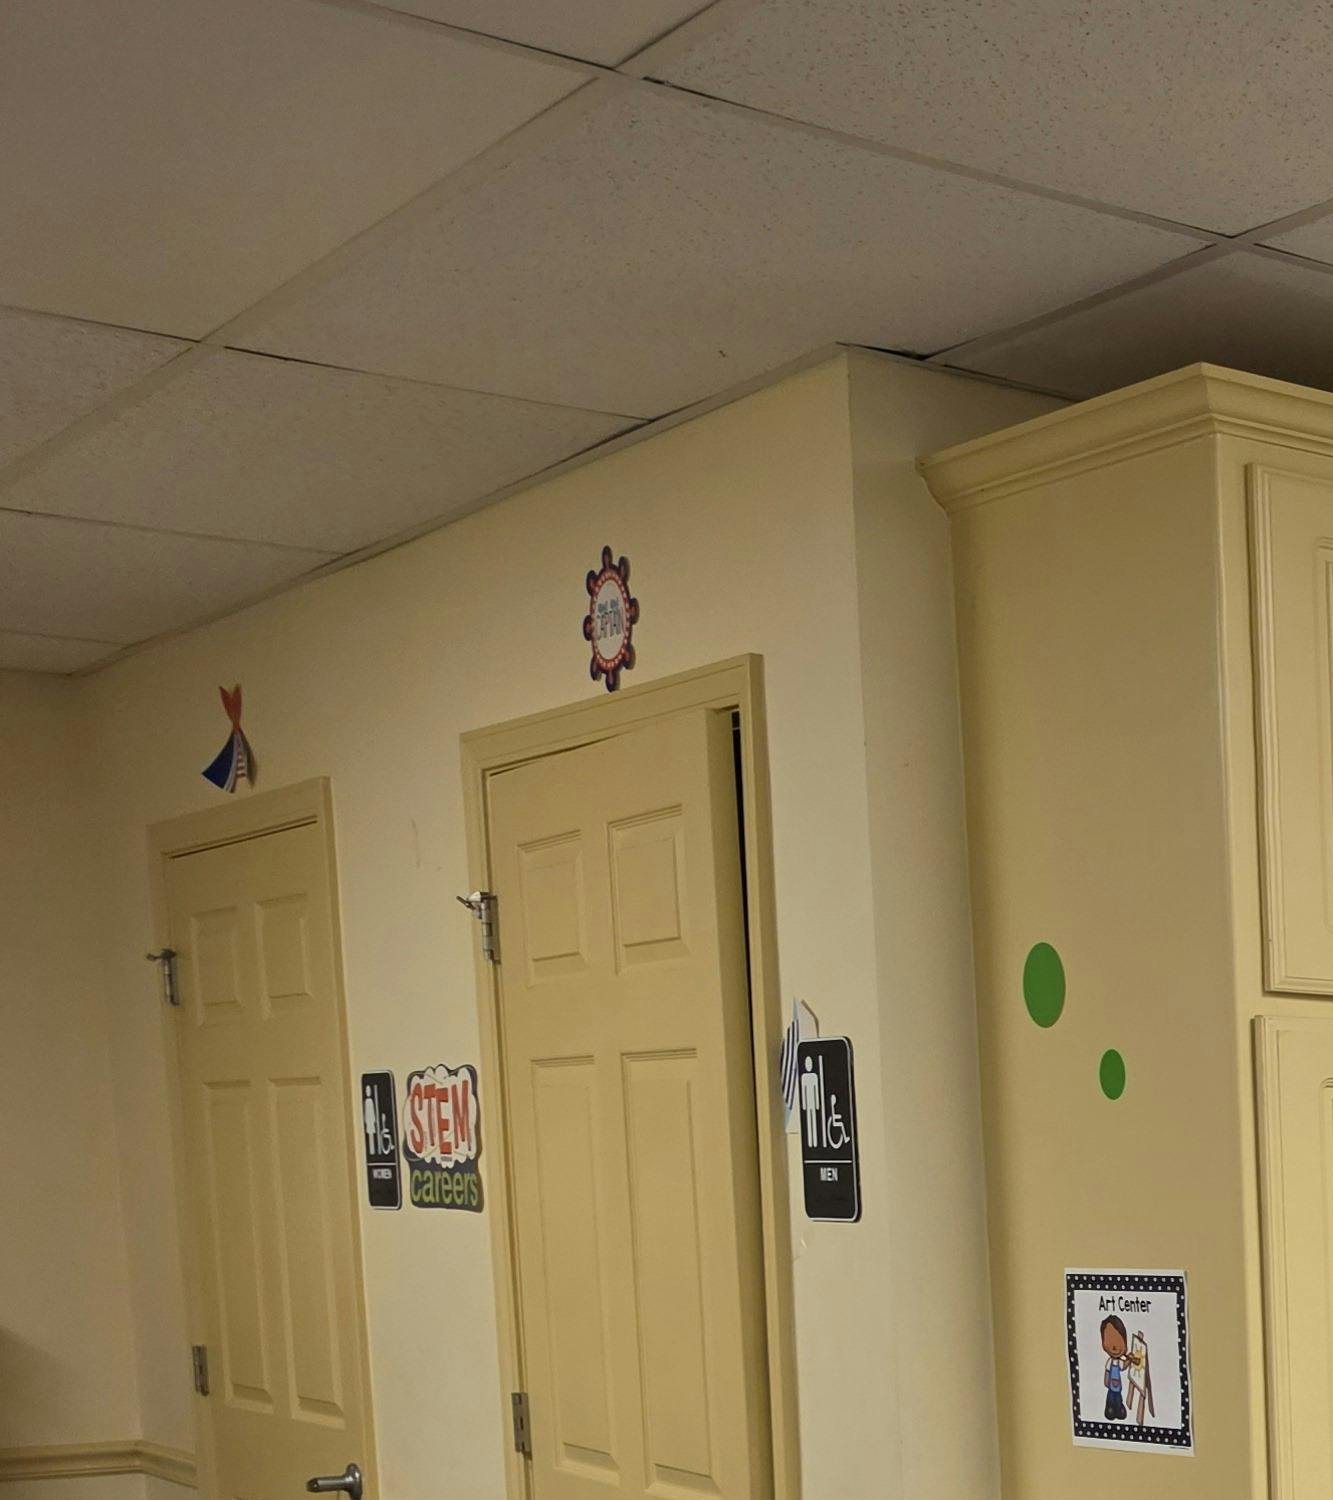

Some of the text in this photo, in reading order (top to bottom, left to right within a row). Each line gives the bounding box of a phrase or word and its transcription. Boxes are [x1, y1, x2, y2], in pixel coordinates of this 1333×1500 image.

[410, 1080, 472, 1155] STEM
[412, 1169, 478, 1206] careers
[820, 1167, 838, 1182] MEN
[1098, 1296, 1152, 1313] Art Center
